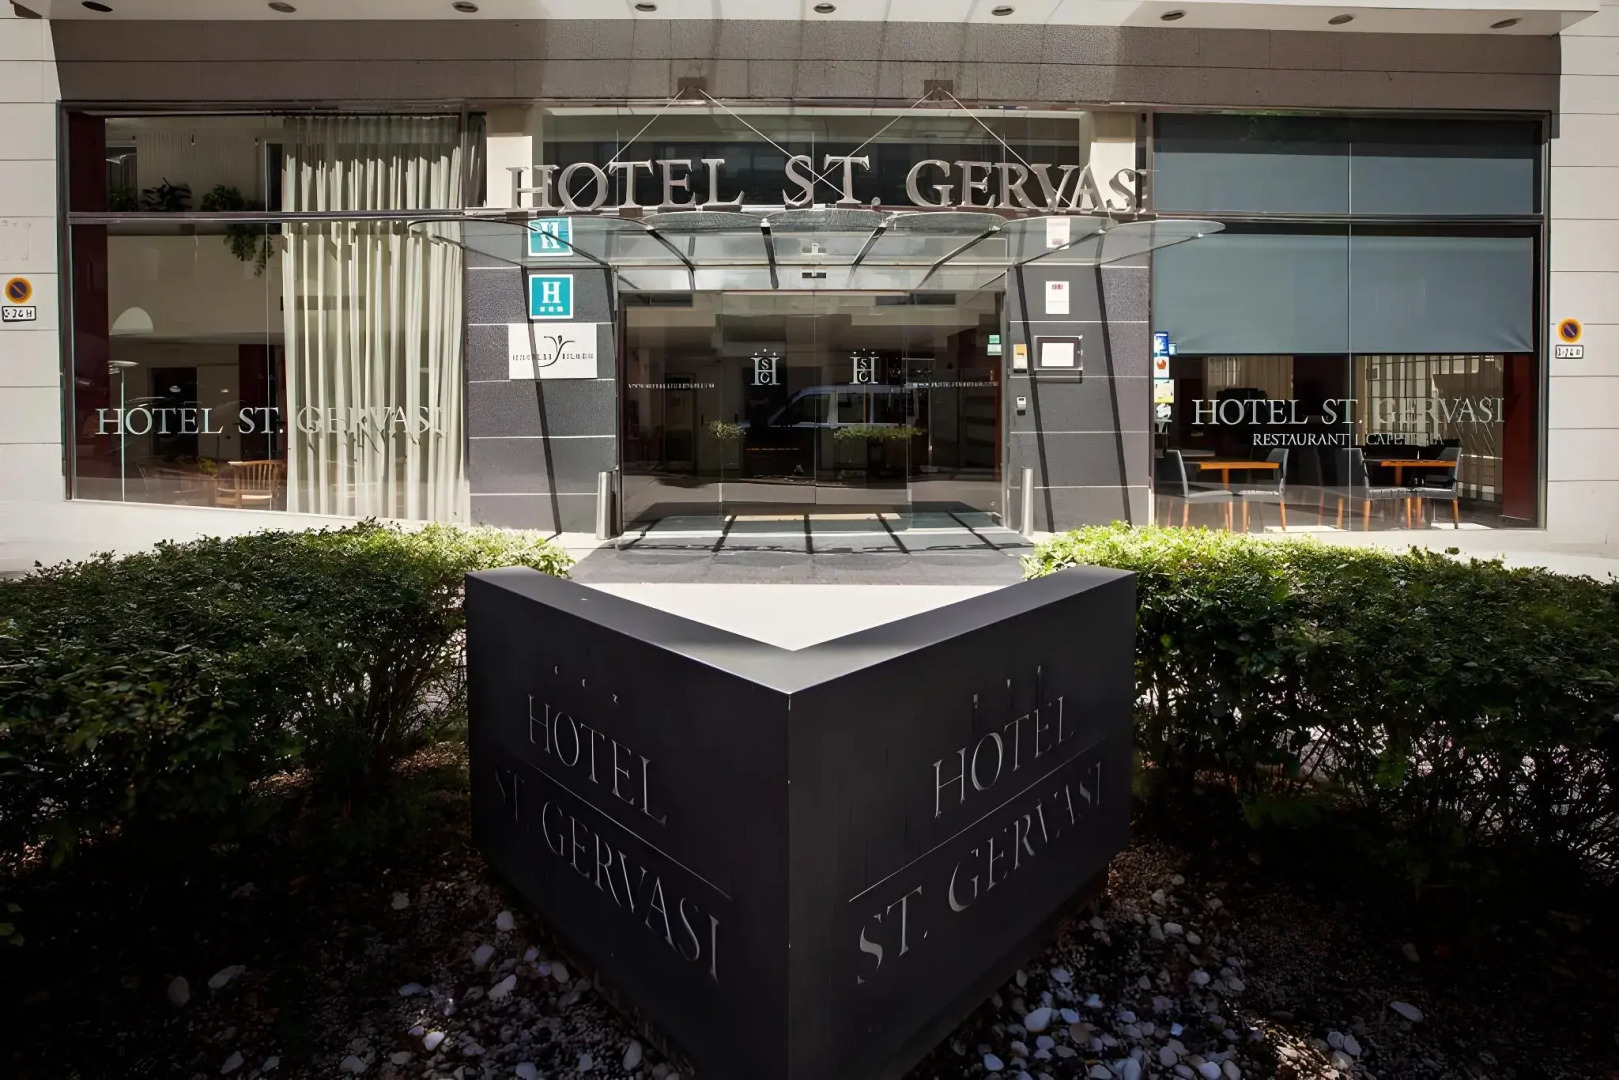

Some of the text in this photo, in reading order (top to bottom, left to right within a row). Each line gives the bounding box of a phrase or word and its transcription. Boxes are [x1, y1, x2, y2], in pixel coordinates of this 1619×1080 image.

[506, 153, 1148, 214] HOTEL ST. GERVASI
[541, 281, 561, 304] H
[95, 407, 224, 435] HOTEL
[238, 407, 284, 434] ST.
[1191, 397, 1505, 425] HOTEL ST. GRVASI
[1252, 433, 1350, 447] RESTAURANT
[528, 694, 667, 826] HOTEL
[932, 696, 1075, 819] HOTEL
[542, 801, 718, 983] GERVASI
